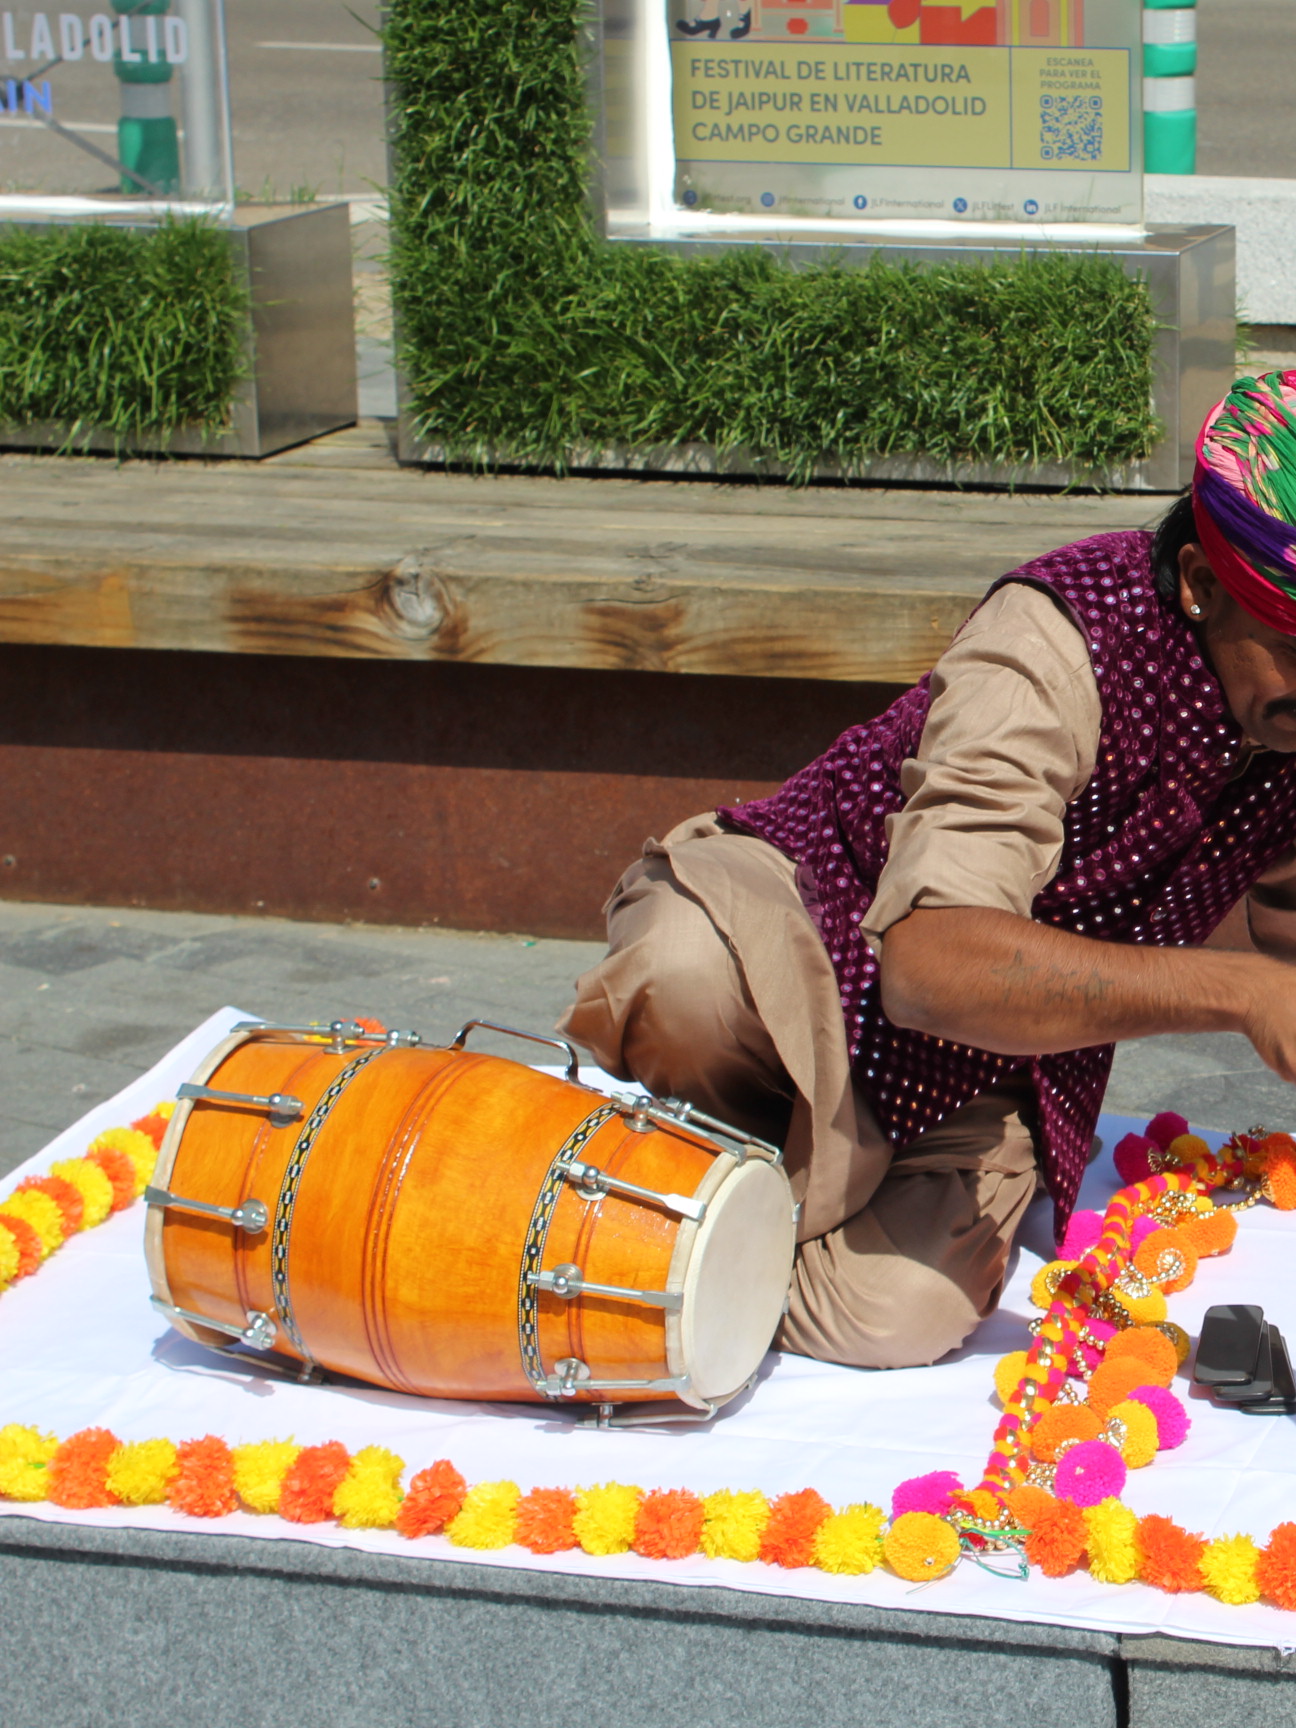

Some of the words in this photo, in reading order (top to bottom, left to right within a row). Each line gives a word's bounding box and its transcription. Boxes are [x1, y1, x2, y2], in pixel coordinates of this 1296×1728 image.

[690, 58, 791, 80] FESTIVAL
[797, 60, 827, 81] DE
[833, 61, 971, 84] LITERATURA
[1046, 57, 1094, 67] ESCANEA
[1040, 69, 1066, 78] PARA
[1068, 70, 1088, 79] VER
[1090, 70, 1102, 79] EL
[1040, 81, 1101, 90] PROGRAMA
[0, 79, 52, 114] IN
[691, 90, 721, 110] DE
[724, 91, 803, 116] JAIPUR
[810, 93, 838, 112] EN
[844, 94, 987, 116] VALLADOLID
[692, 122, 780, 143] CAMPO
[786, 124, 883, 145] GRANDE
